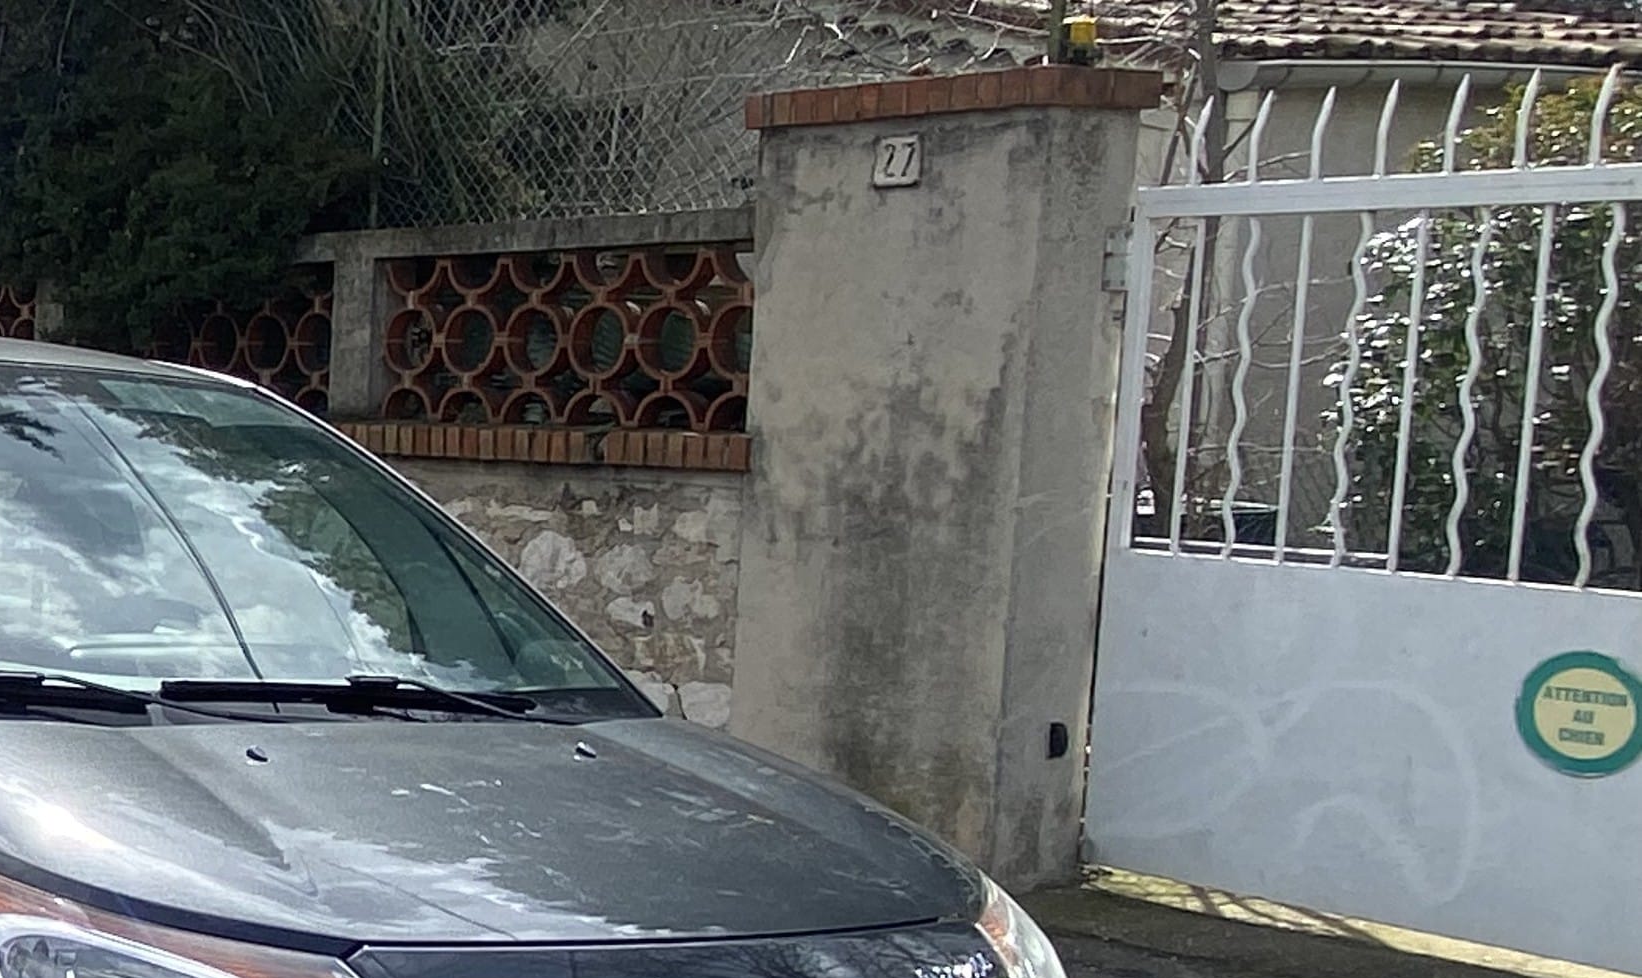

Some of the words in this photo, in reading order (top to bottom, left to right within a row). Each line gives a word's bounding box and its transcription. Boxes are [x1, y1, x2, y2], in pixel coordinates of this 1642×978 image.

[884, 142, 916, 177] 27
[1542, 686, 1627, 707] ATTENTION
[1573, 709, 1595, 724] AU
[1559, 727, 1605, 745] CHIEN
